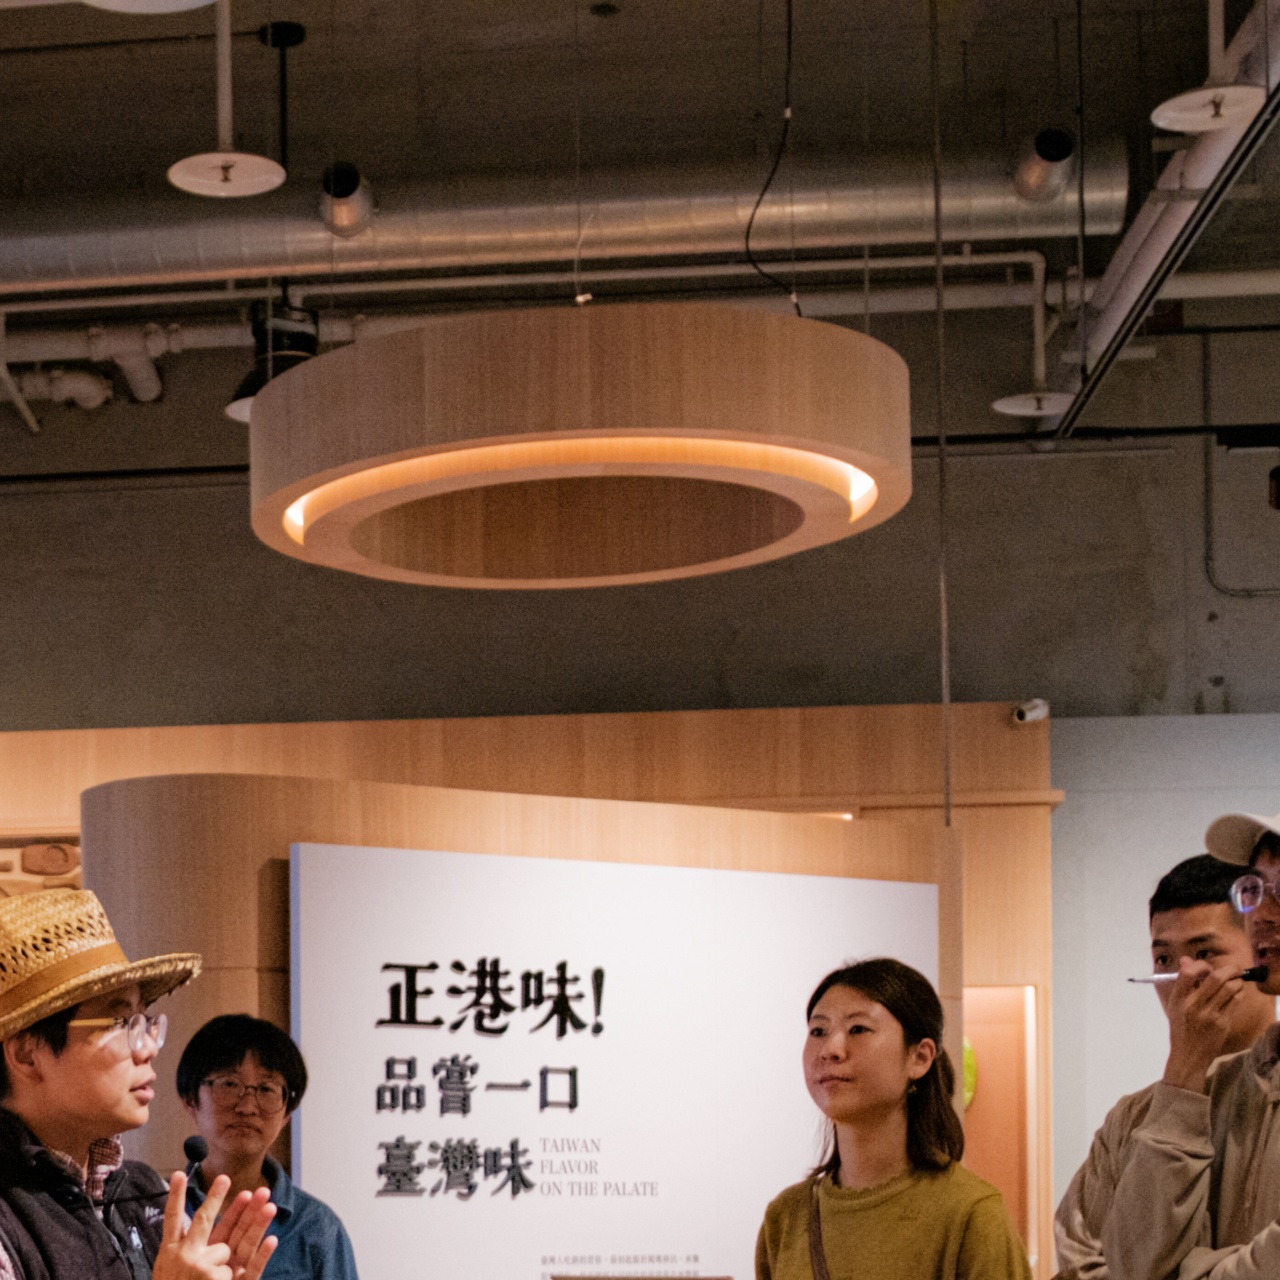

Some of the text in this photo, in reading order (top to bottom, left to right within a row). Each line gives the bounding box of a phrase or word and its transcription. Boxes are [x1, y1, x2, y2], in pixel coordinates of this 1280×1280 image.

[374, 956, 607, 1040] 正港味!
[375, 1054, 580, 1118] 品嘗一口
[539, 1137, 601, 1153] TAIWAN
[374, 1135, 536, 1201] 臺灣味
[539, 1159, 599, 1175] FLAVOR
[539, 1181, 659, 1197] ON THE PALATE
